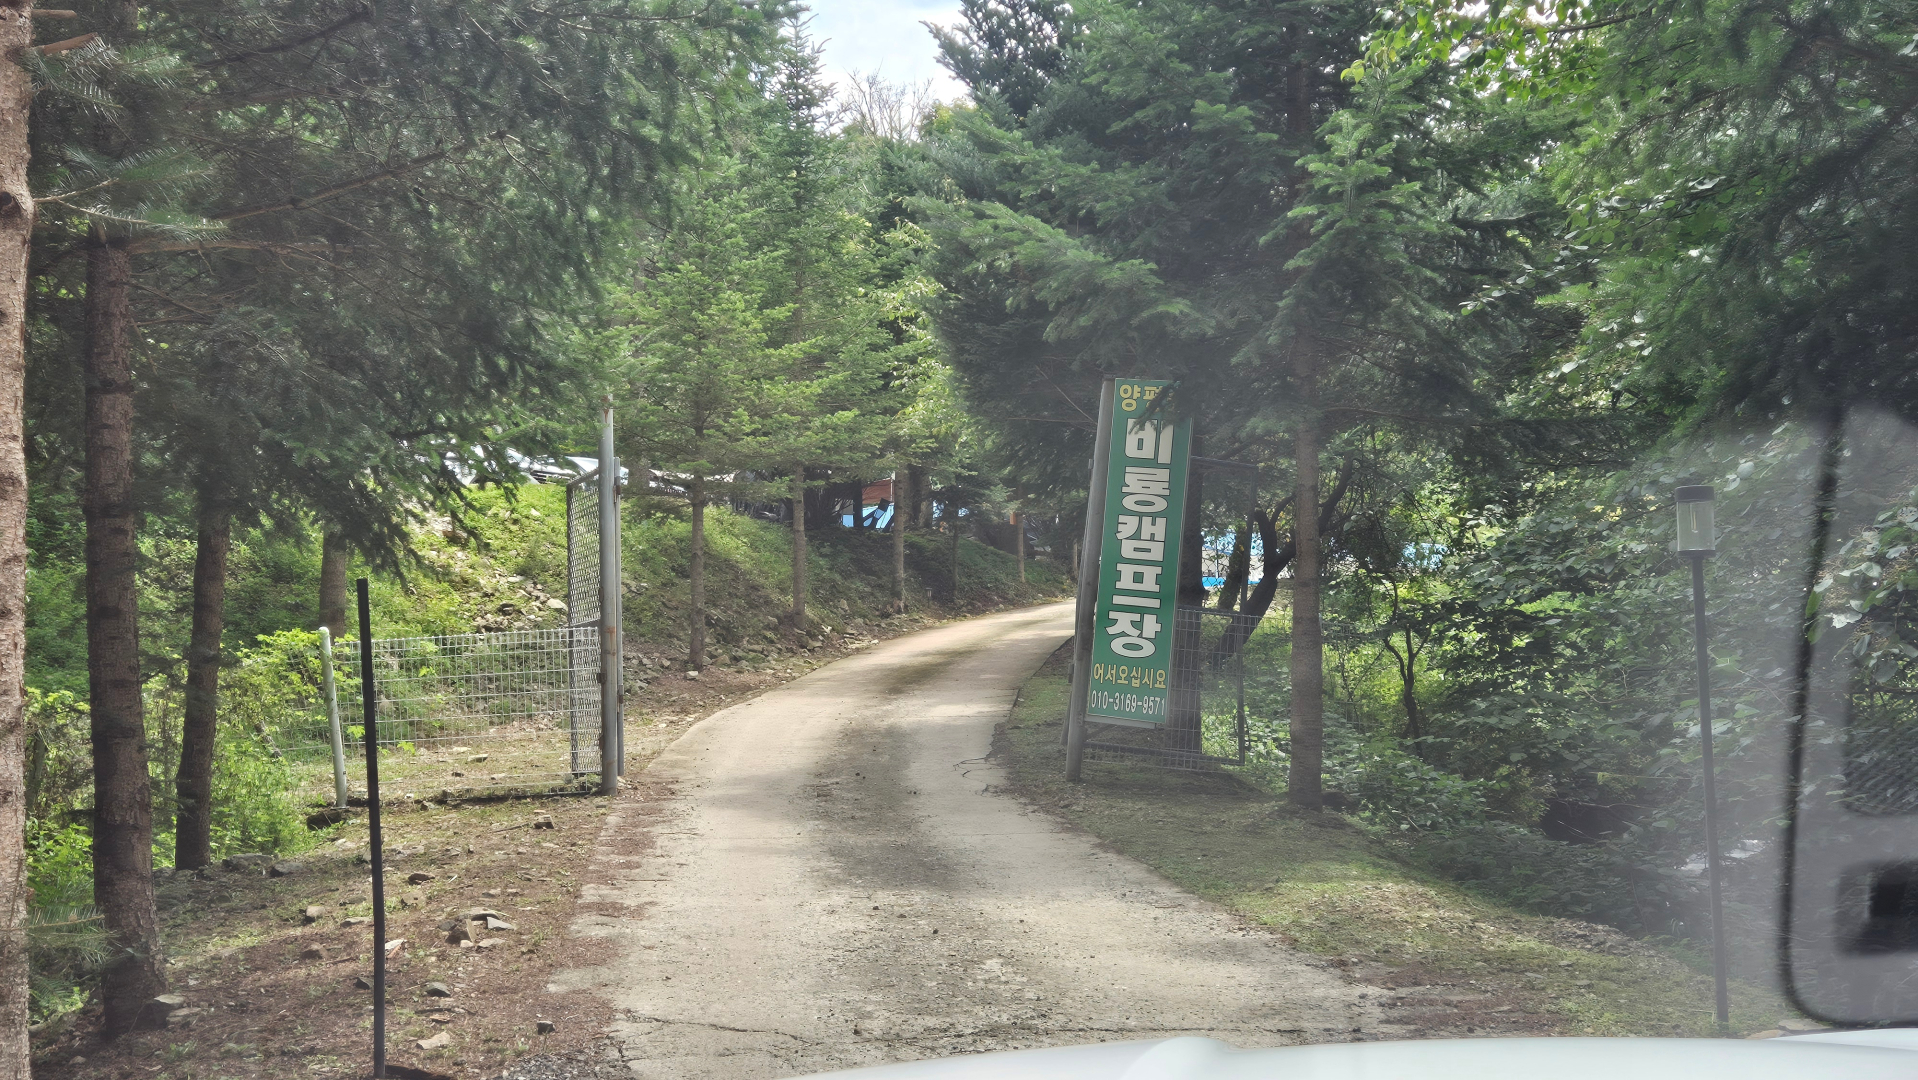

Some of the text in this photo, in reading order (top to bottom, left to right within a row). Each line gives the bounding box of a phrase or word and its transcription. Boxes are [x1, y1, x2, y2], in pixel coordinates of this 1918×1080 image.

[1105, 418, 1174, 658] 비룡캠프장
[1093, 663, 1166, 689] 어서오십시요
[1091, 689, 1165, 716] 010-3169-9571
